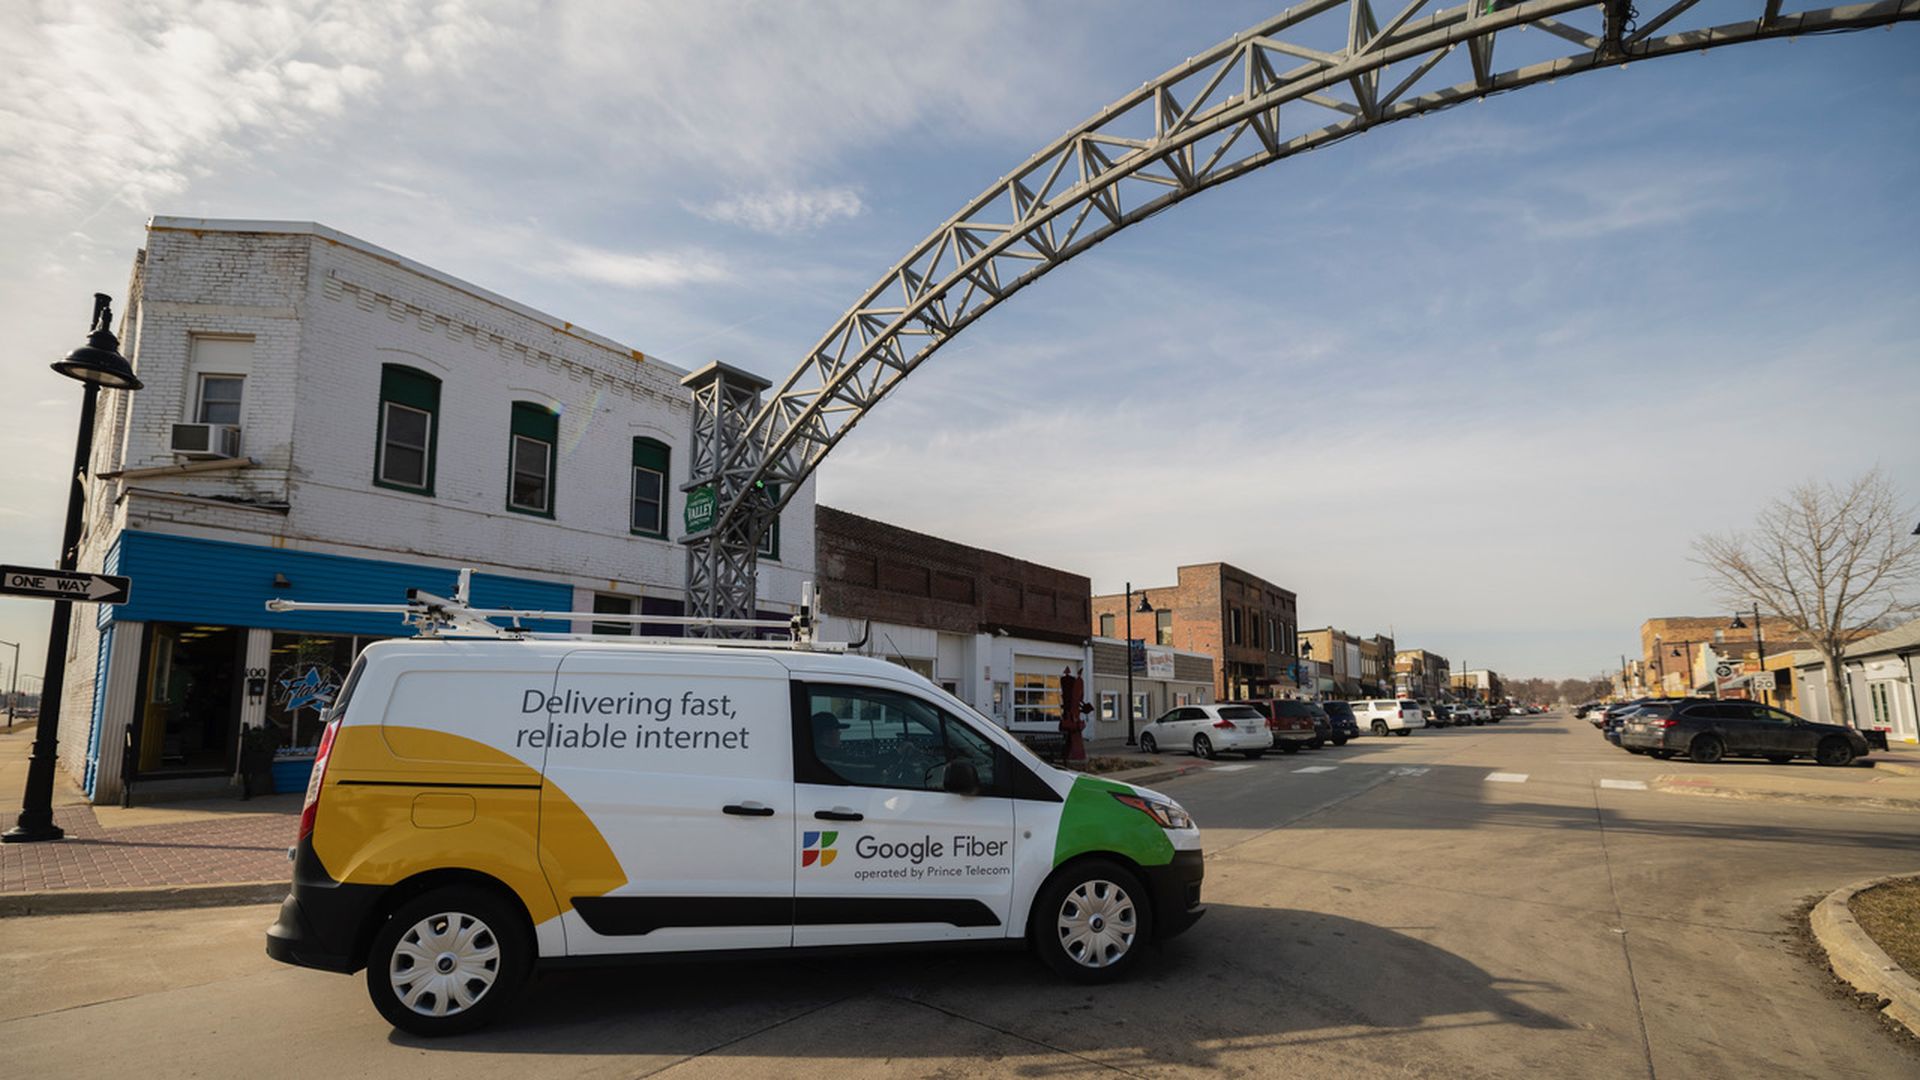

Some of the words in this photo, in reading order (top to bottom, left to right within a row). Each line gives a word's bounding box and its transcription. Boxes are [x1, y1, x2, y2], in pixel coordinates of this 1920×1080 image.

[687, 501, 714, 520] VALLEY
[12, 575, 46, 588] ONE
[57, 579, 92, 593] WAY
[1755, 680, 1774, 689] 20
[521, 689, 672, 722] Delivering
[681, 691, 737, 719] fast,
[516, 722, 627, 749] reliable
[636, 724, 750, 749] internet
[855, 834, 944, 865] Google
[953, 835, 1008, 857] Fiber
[854, 867, 907, 881] operated
[910, 867, 925, 879] by
[927, 866, 962, 877] Prince
[965, 865, 1010, 876] Telecom
